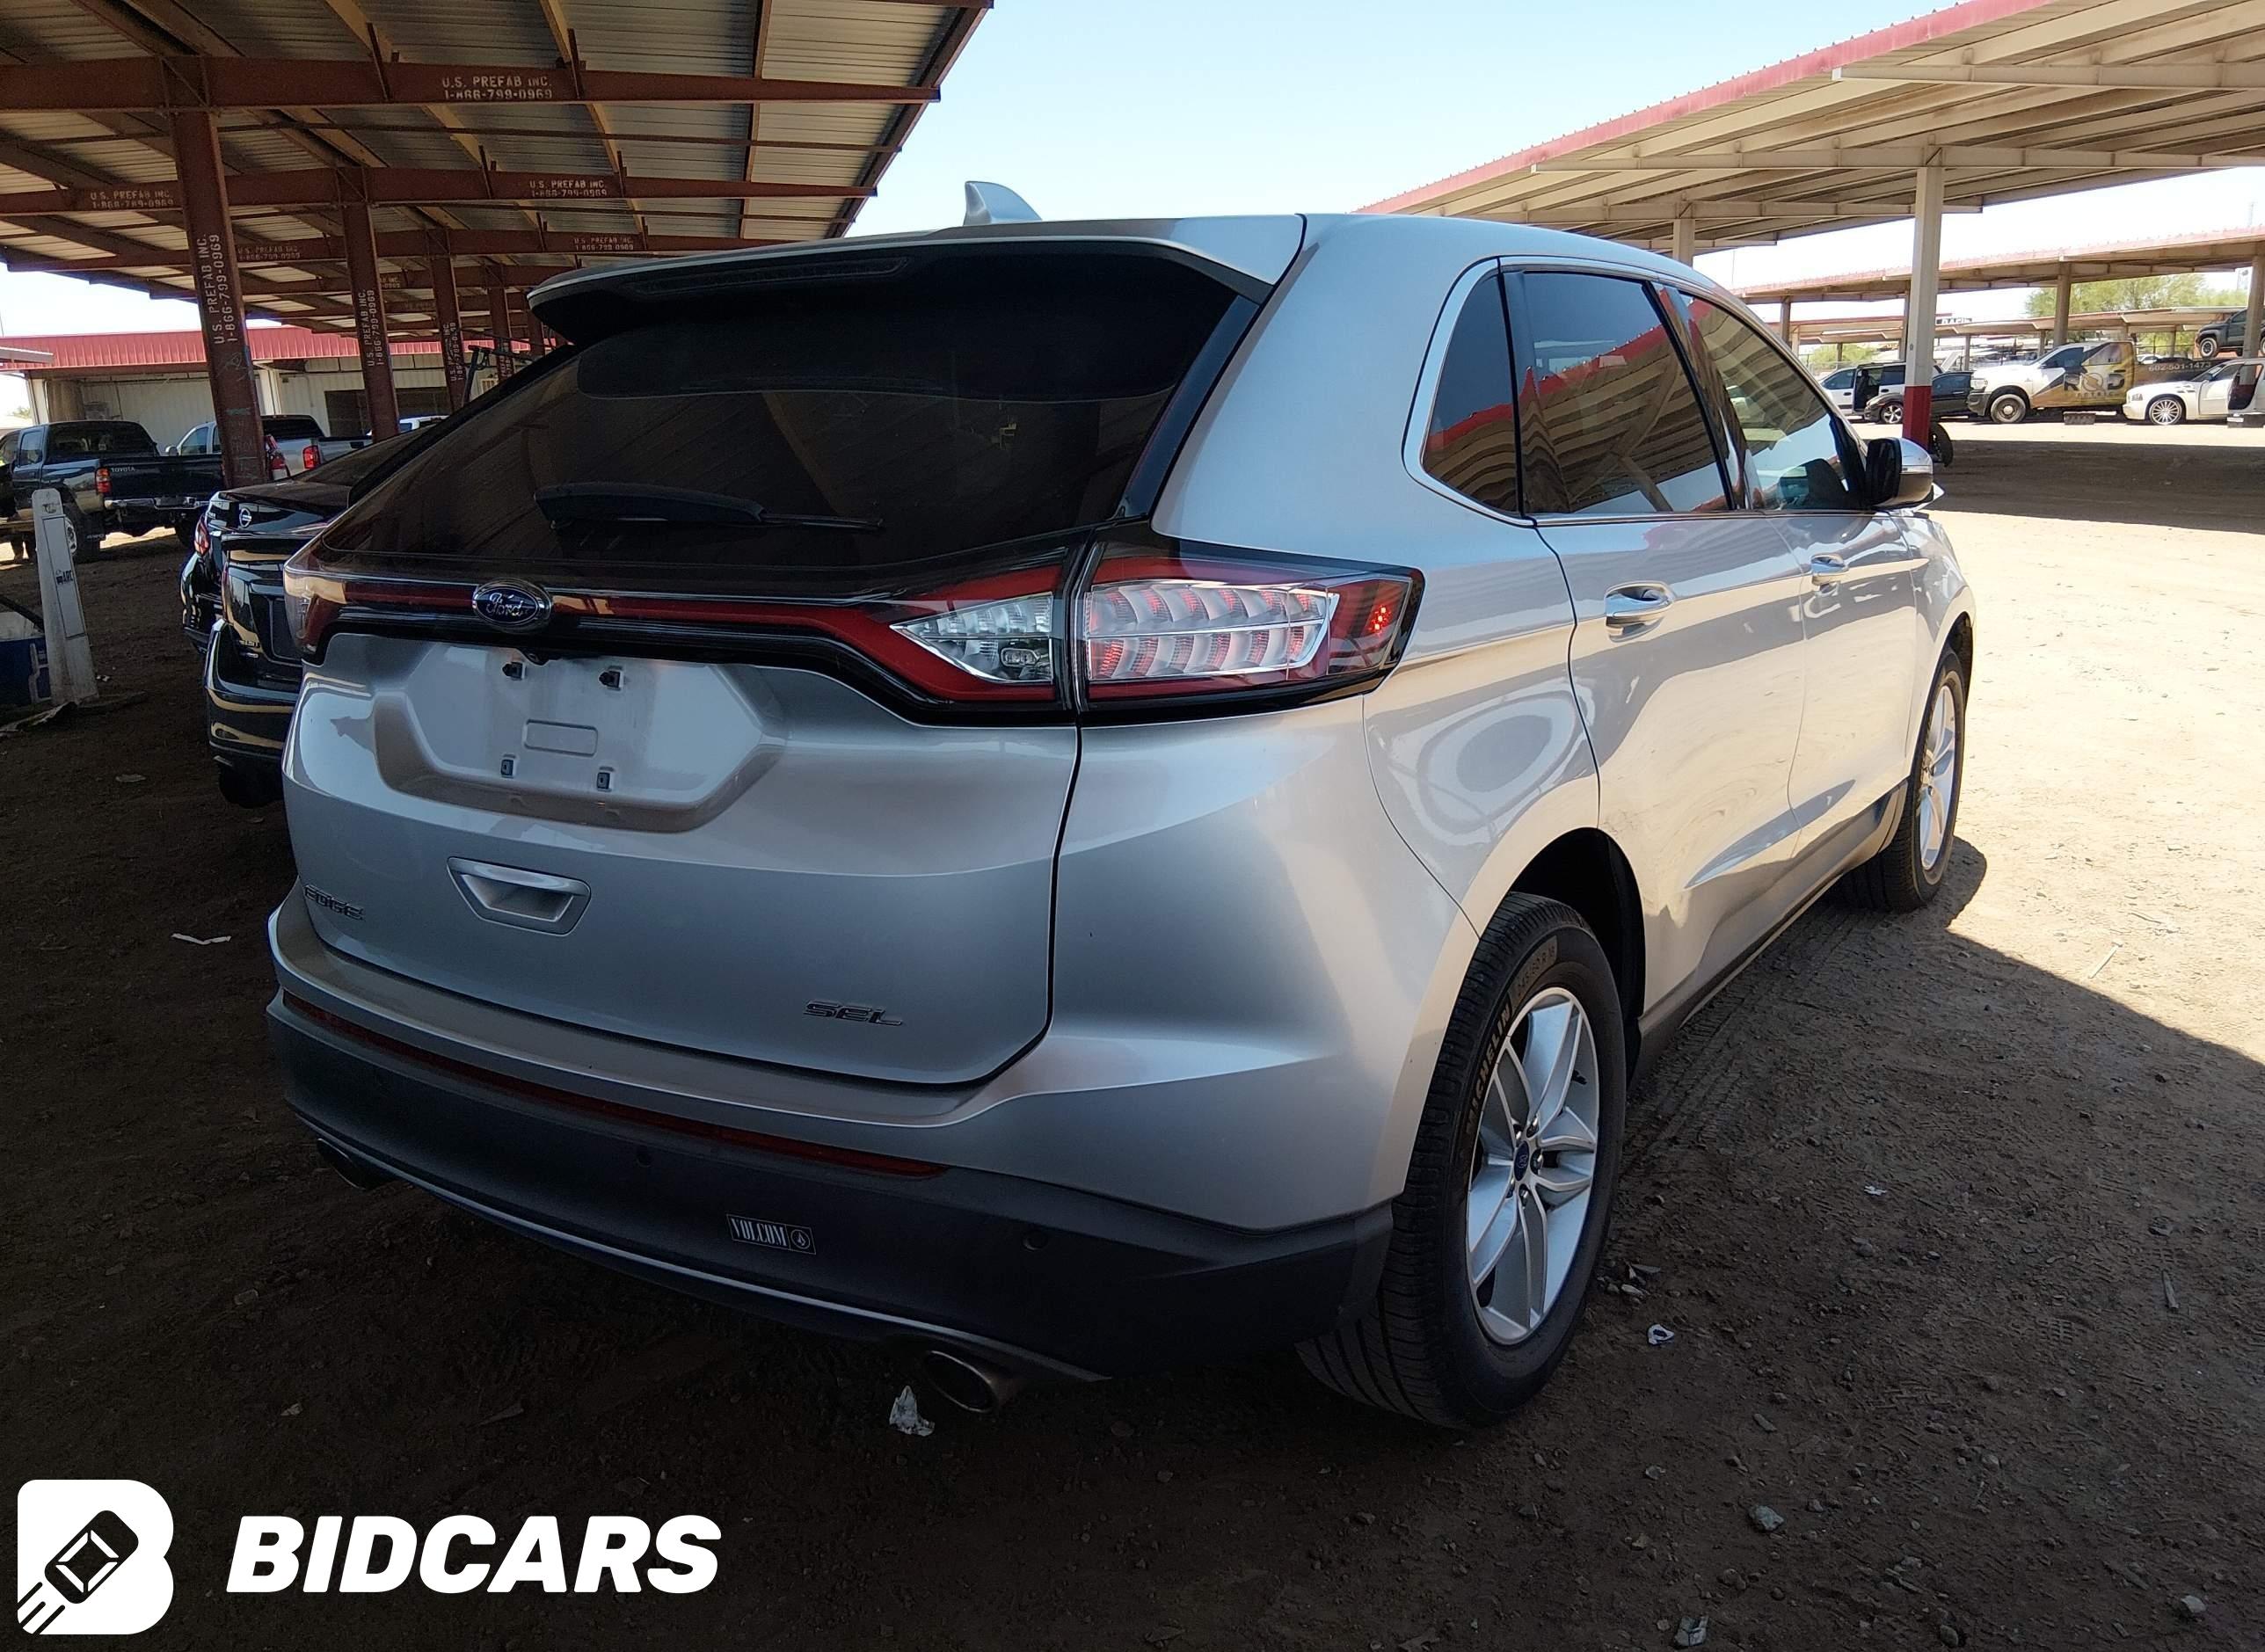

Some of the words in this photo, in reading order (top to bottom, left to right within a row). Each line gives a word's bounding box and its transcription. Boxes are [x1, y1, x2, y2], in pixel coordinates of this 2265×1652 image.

[442, 76, 467, 88] U.S.
[473, 76, 522, 87] PREFAB
[528, 76, 552, 86] INC.
[551, 179, 586, 189] PREFAB
[197, 234, 211, 258] INC.
[200, 265, 220, 314] PREFAB
[209, 235, 238, 342] 1-866-799-0969
[358, 289, 368, 309] INC.
[212, 320, 225, 344] U.S.
[361, 310, 373, 346] PREFAB
[366, 351, 375, 367] U.S.
[302, 885, 364, 921] EDGE
[804, 1001, 904, 1027] SEL
[1466, 1002, 1511, 1134] MICHELIN
